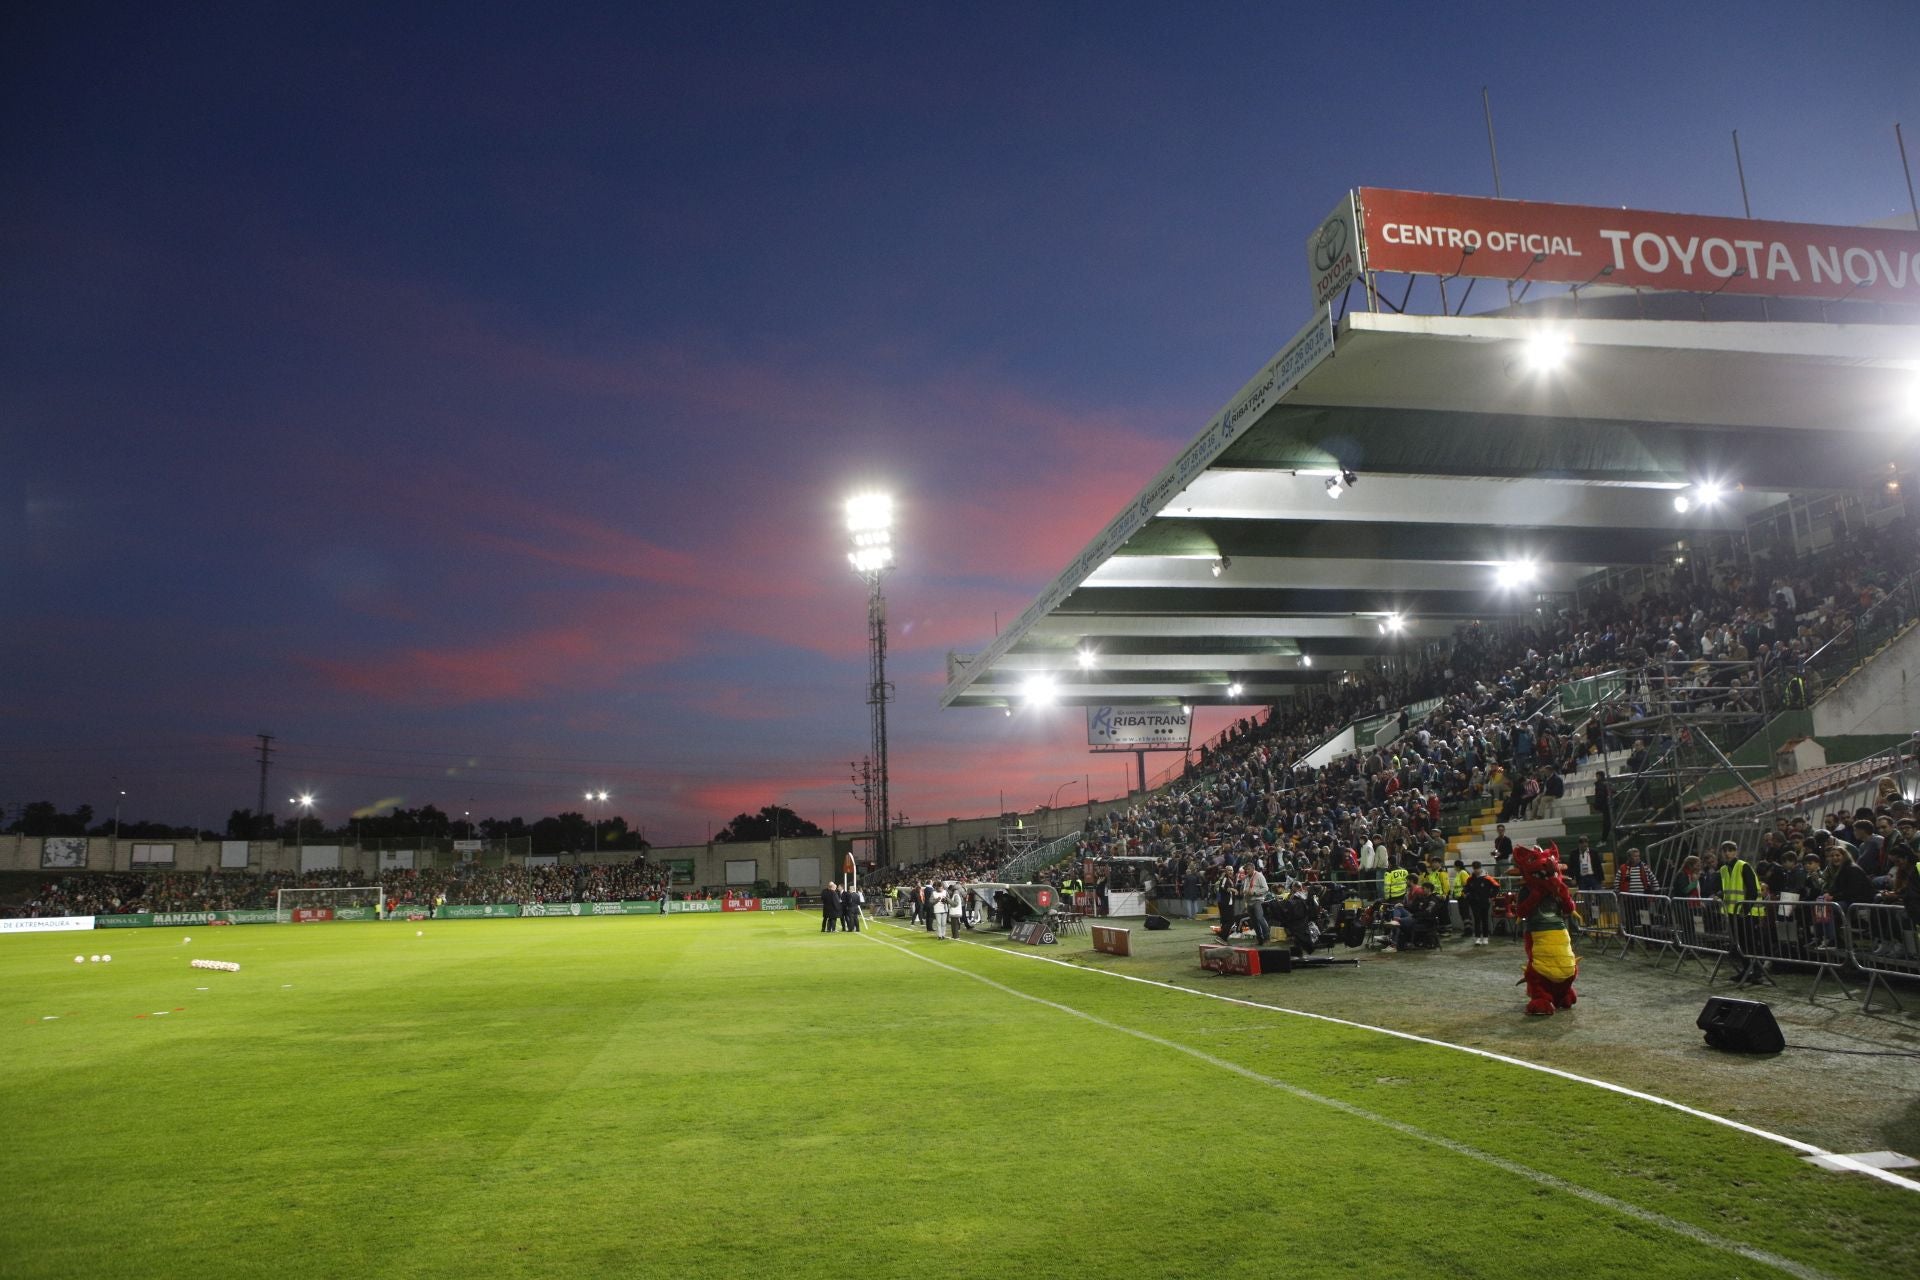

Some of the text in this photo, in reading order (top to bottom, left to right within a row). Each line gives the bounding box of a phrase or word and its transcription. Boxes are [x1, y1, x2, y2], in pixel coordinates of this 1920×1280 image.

[1382, 223, 1482, 250] CENTRO
[1487, 231, 1582, 257] OFICIAL
[1600, 229, 1801, 282] TOYOTA
[1317, 253, 1353, 294] TOYOTA
[1319, 268, 1354, 306] NOVOMOTOR
[1281, 329, 1324, 377] 927 26 00 16
[1231, 378, 1274, 425] RIBATRANS
[1113, 716, 1187, 726] RIBATRANS
[15, 920, 71, 928] EXTREMADURA
[153, 913, 217, 923] MANZANO
[682, 901, 710, 911] LERA
